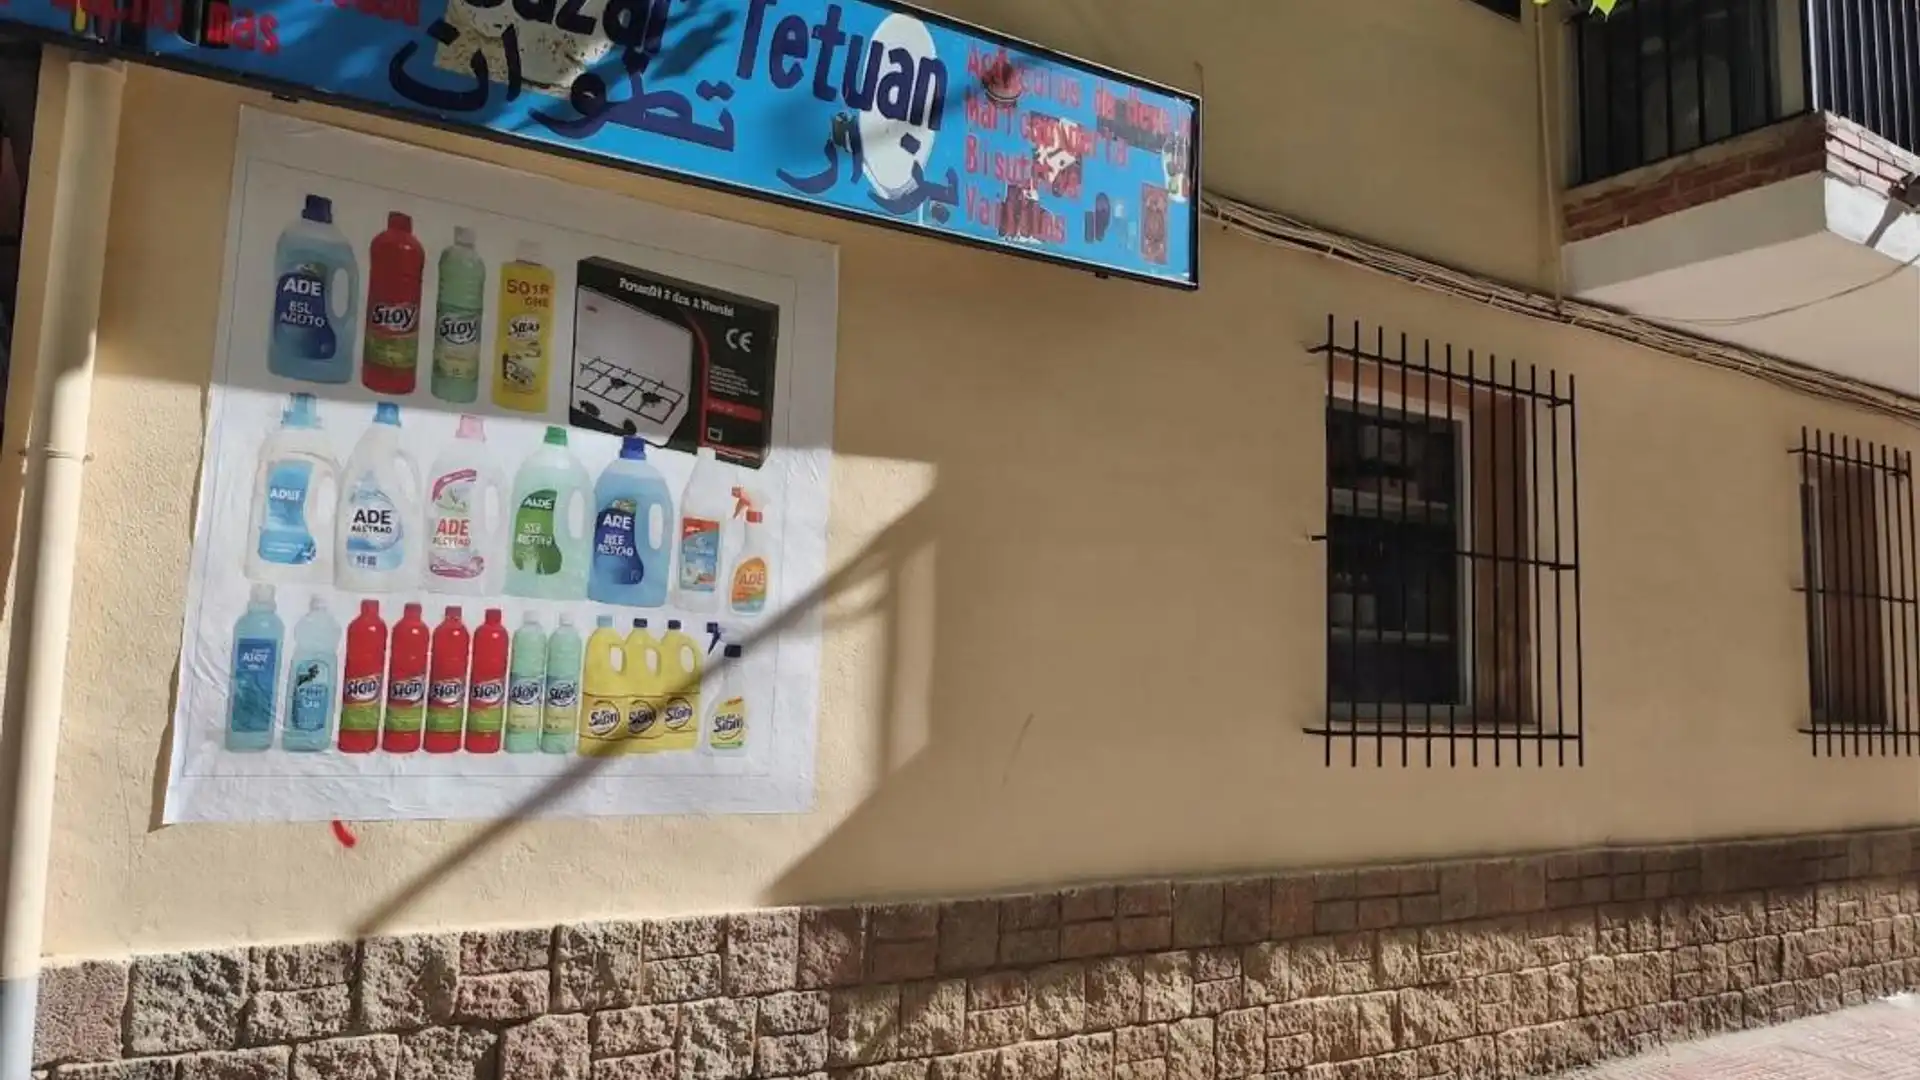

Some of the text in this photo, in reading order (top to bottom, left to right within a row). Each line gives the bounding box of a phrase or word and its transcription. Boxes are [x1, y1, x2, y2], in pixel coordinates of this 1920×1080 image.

[736, 0, 948, 131] Tetuan
[283, 277, 322, 297] ADE
[353, 509, 393, 525] ADE
[436, 518, 470, 537] ADE
